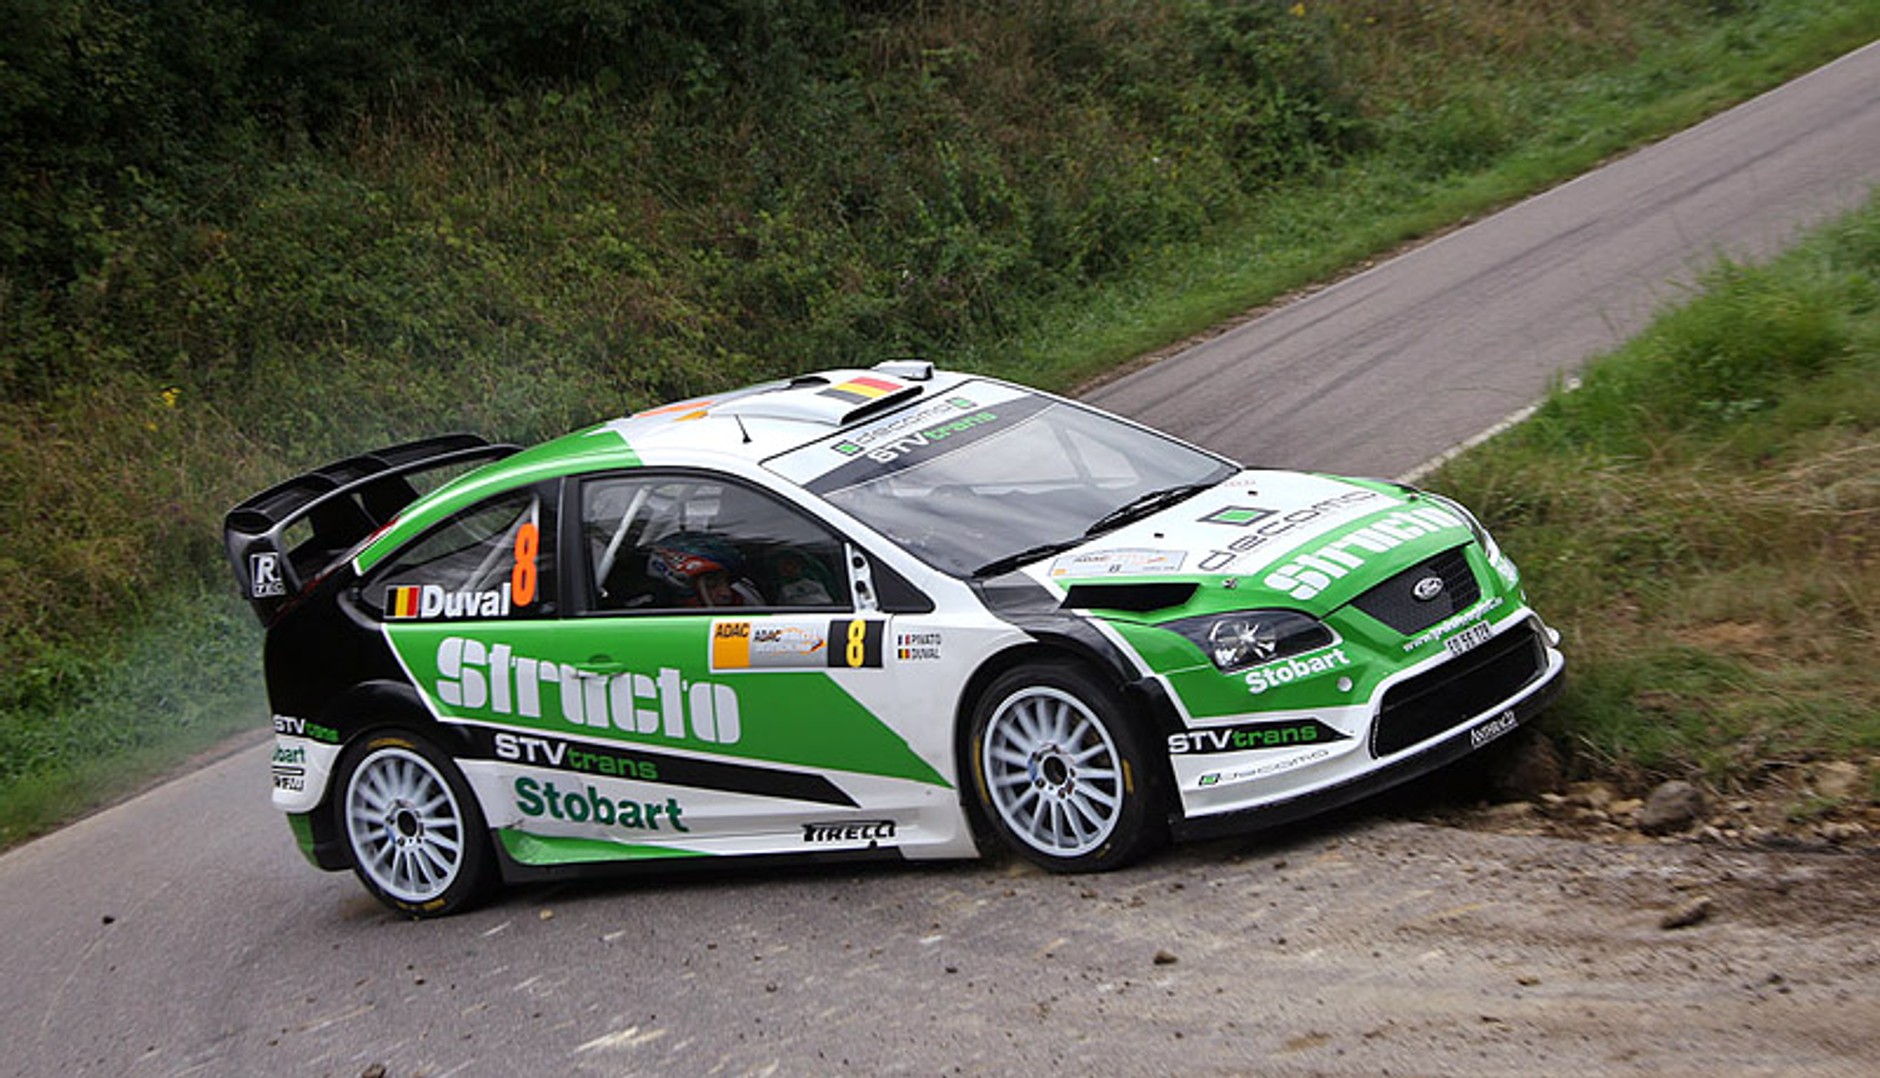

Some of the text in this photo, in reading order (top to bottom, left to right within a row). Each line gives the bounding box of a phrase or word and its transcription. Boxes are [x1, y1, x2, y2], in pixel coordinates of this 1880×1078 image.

[1199, 491, 1377, 571] decomo
[512, 522, 539, 607] 8
[421, 583, 511, 617] Duval
[714, 623, 750, 640] ADAC
[846, 618, 867, 668] 8
[436, 636, 742, 744] Structo
[1245, 648, 1351, 694] Stobart
[495, 733, 659, 780] STVtrans
[1167, 725, 1318, 754] STVtrans
[514, 776, 690, 832] Stobart
[801, 820, 897, 842] PIRELLI
